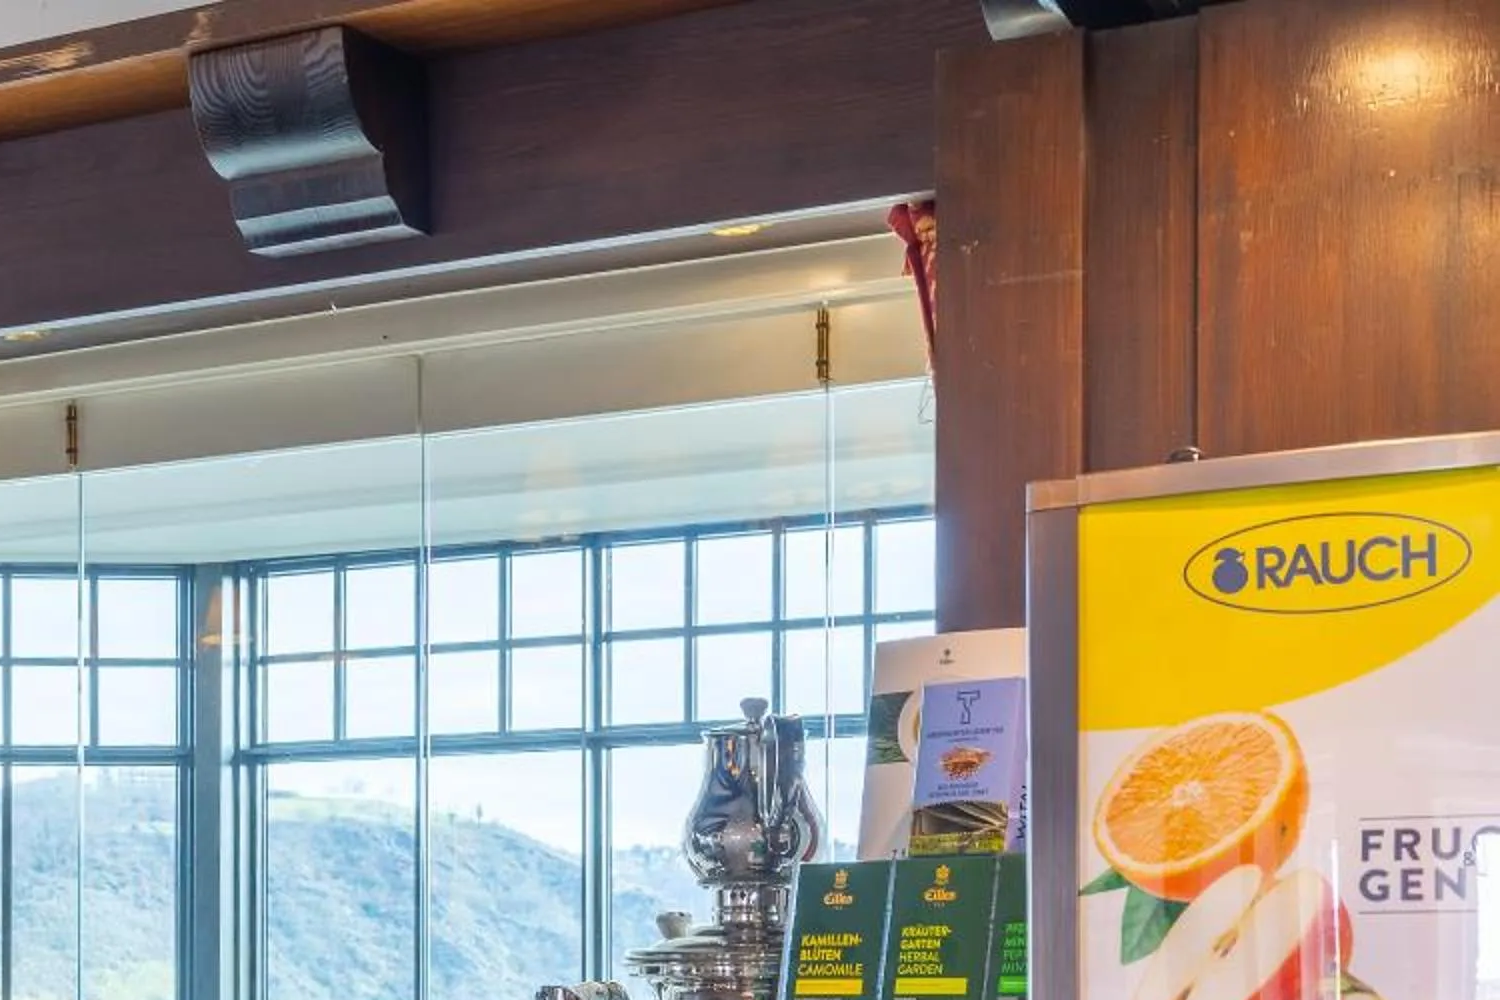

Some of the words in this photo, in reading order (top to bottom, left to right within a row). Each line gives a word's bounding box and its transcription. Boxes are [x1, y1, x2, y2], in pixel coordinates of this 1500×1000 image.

[1256, 532, 1437, 590] RAUCH
[802, 933, 863, 947] KAMILLEN-
[900, 938, 941, 950] GARTEN
[900, 951, 940, 963] HERBAL
[798, 963, 863, 977] CAMOMILE
[898, 963, 943, 976] GARDEN
